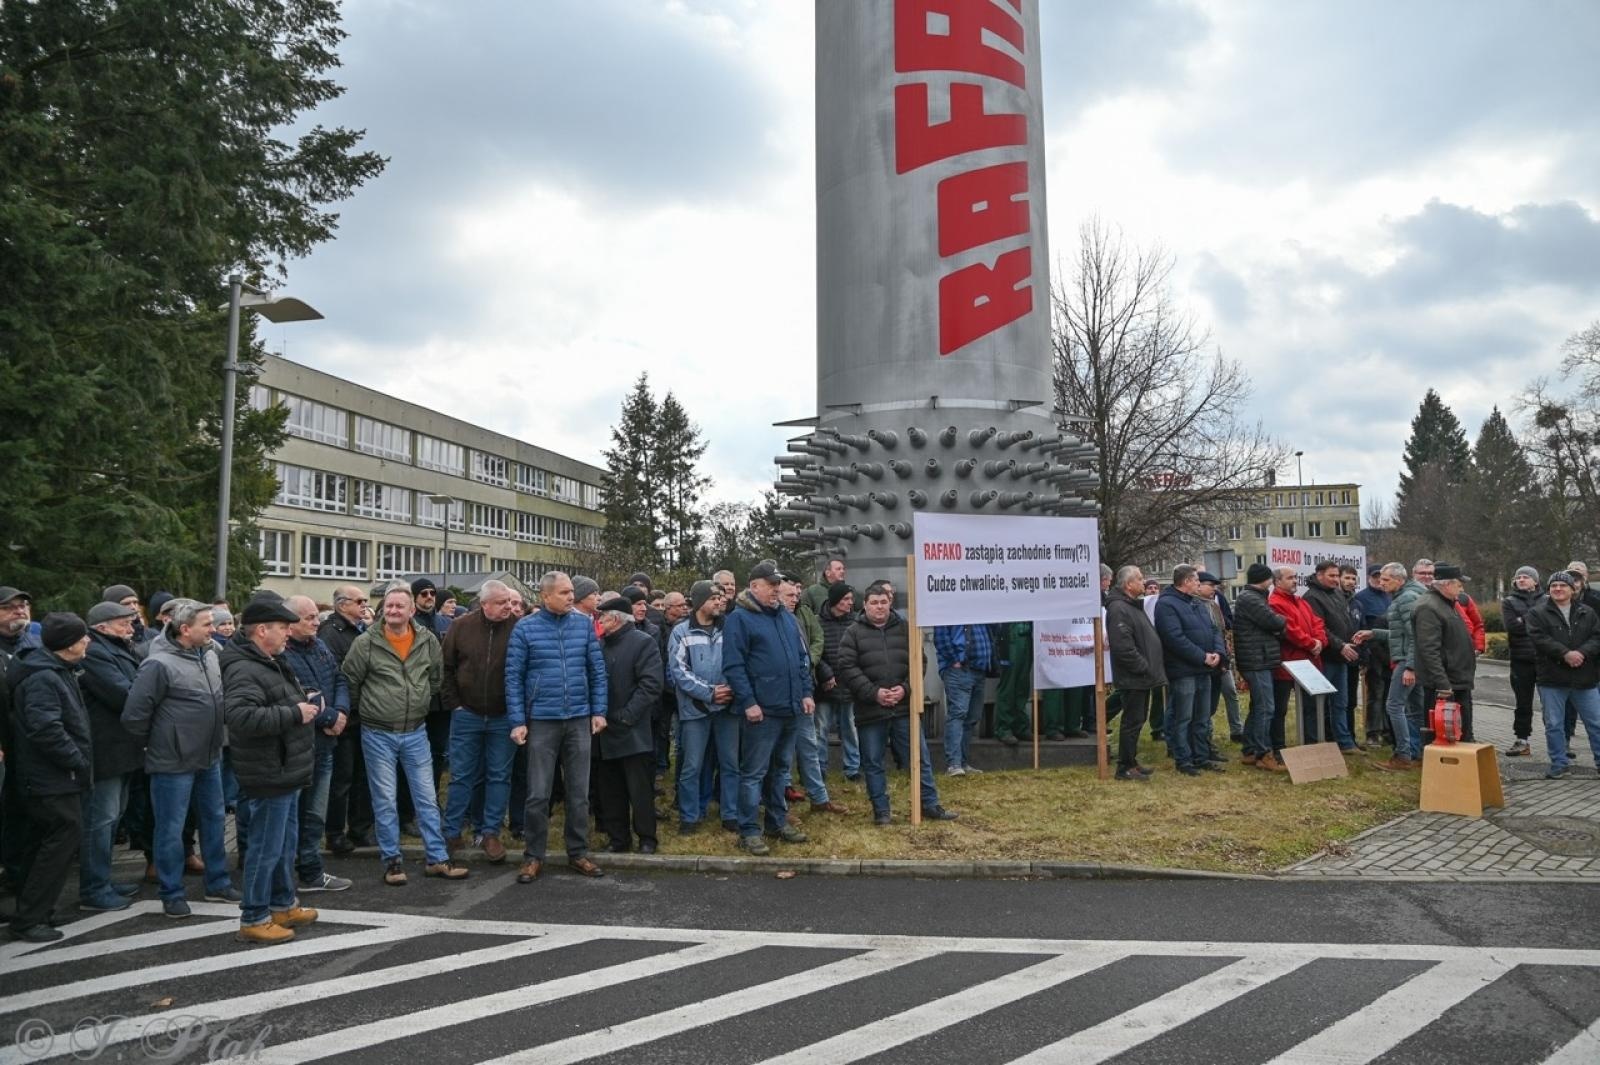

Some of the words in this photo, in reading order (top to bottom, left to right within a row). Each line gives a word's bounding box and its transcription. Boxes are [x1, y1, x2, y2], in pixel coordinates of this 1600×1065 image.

[894, 0, 1033, 356] RAFA
[923, 543, 962, 561] RAFAKO
[965, 543, 1005, 565] zastąpią
[1006, 543, 1052, 561] zachodnie
[1054, 543, 1091, 563] firmy(?!)
[1271, 548, 1302, 565] RAFAKO
[1303, 551, 1312, 566] to
[927, 574, 957, 592] Cudze
[960, 573, 1008, 593] chwalicie,
[1011, 576, 1040, 593] swego
[1043, 572, 1057, 590] nie
[1059, 572, 1090, 589] znacie!
